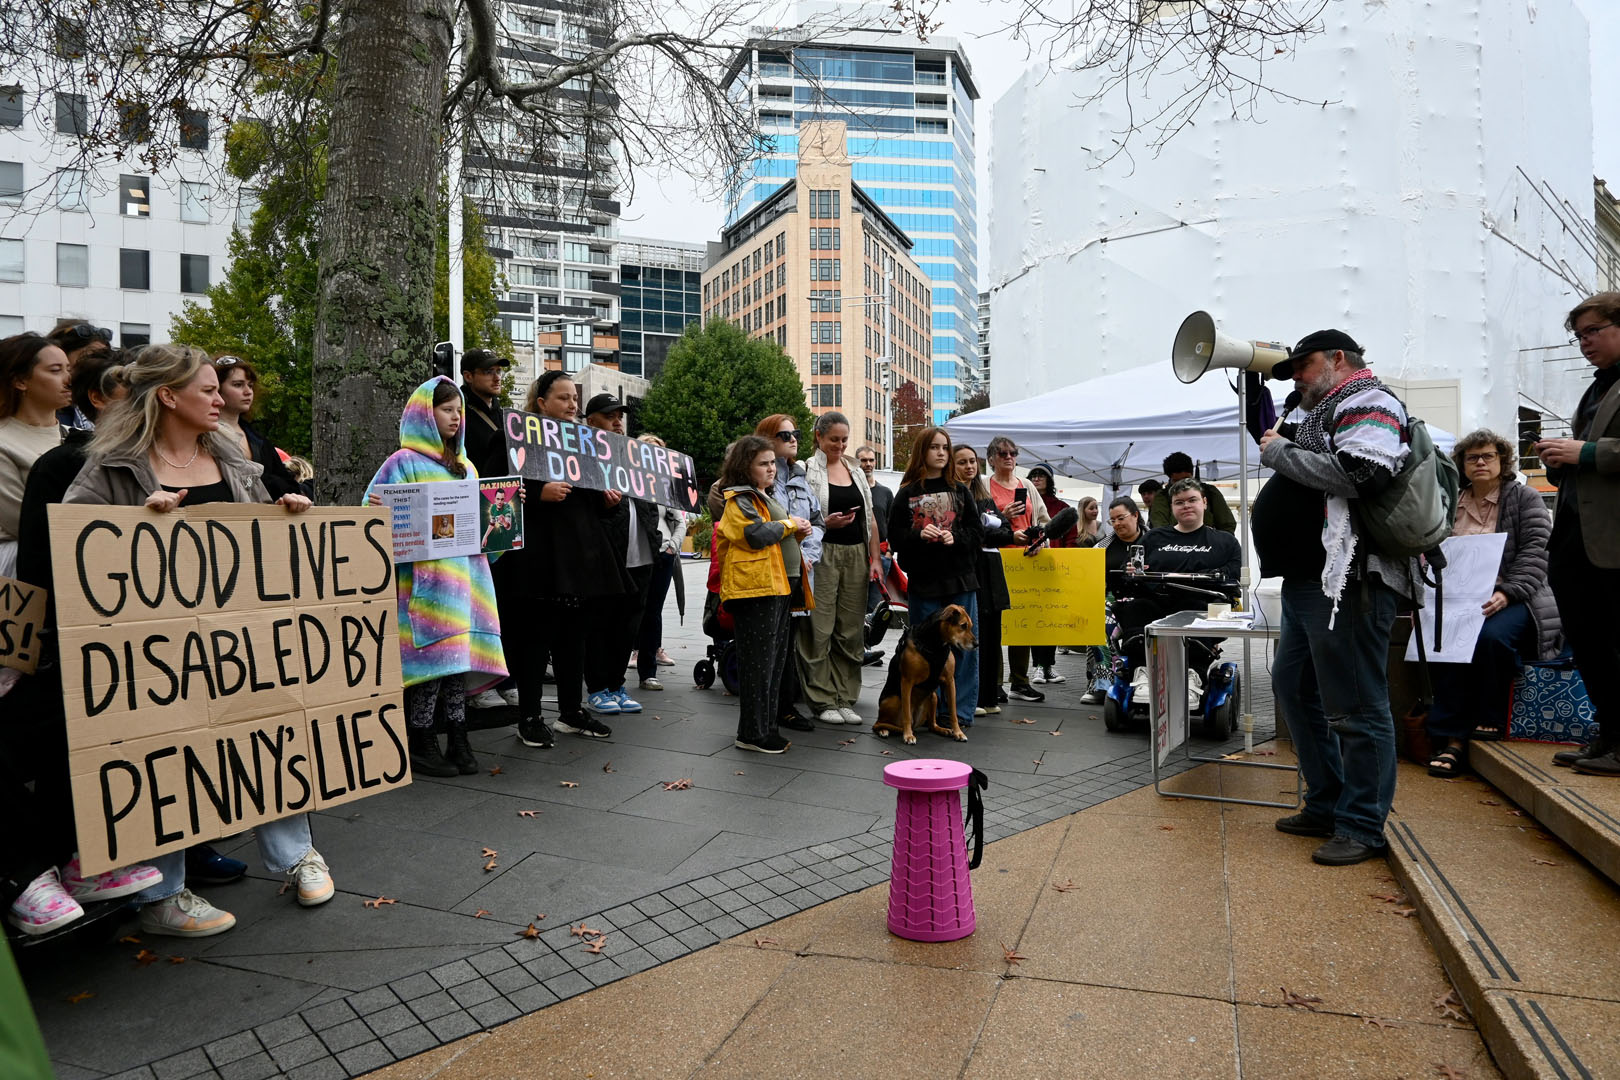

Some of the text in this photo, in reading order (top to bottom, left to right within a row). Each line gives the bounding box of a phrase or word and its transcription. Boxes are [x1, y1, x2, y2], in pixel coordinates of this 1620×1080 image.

[507, 412, 612, 460] CARERS
[547, 451, 581, 481] DO
[480, 480, 521, 491] BAZINGA!
[75, 518, 393, 617] GOOD LIVES
[81, 610, 388, 717] DISABLED BY
[311, 703, 408, 801] LIES
